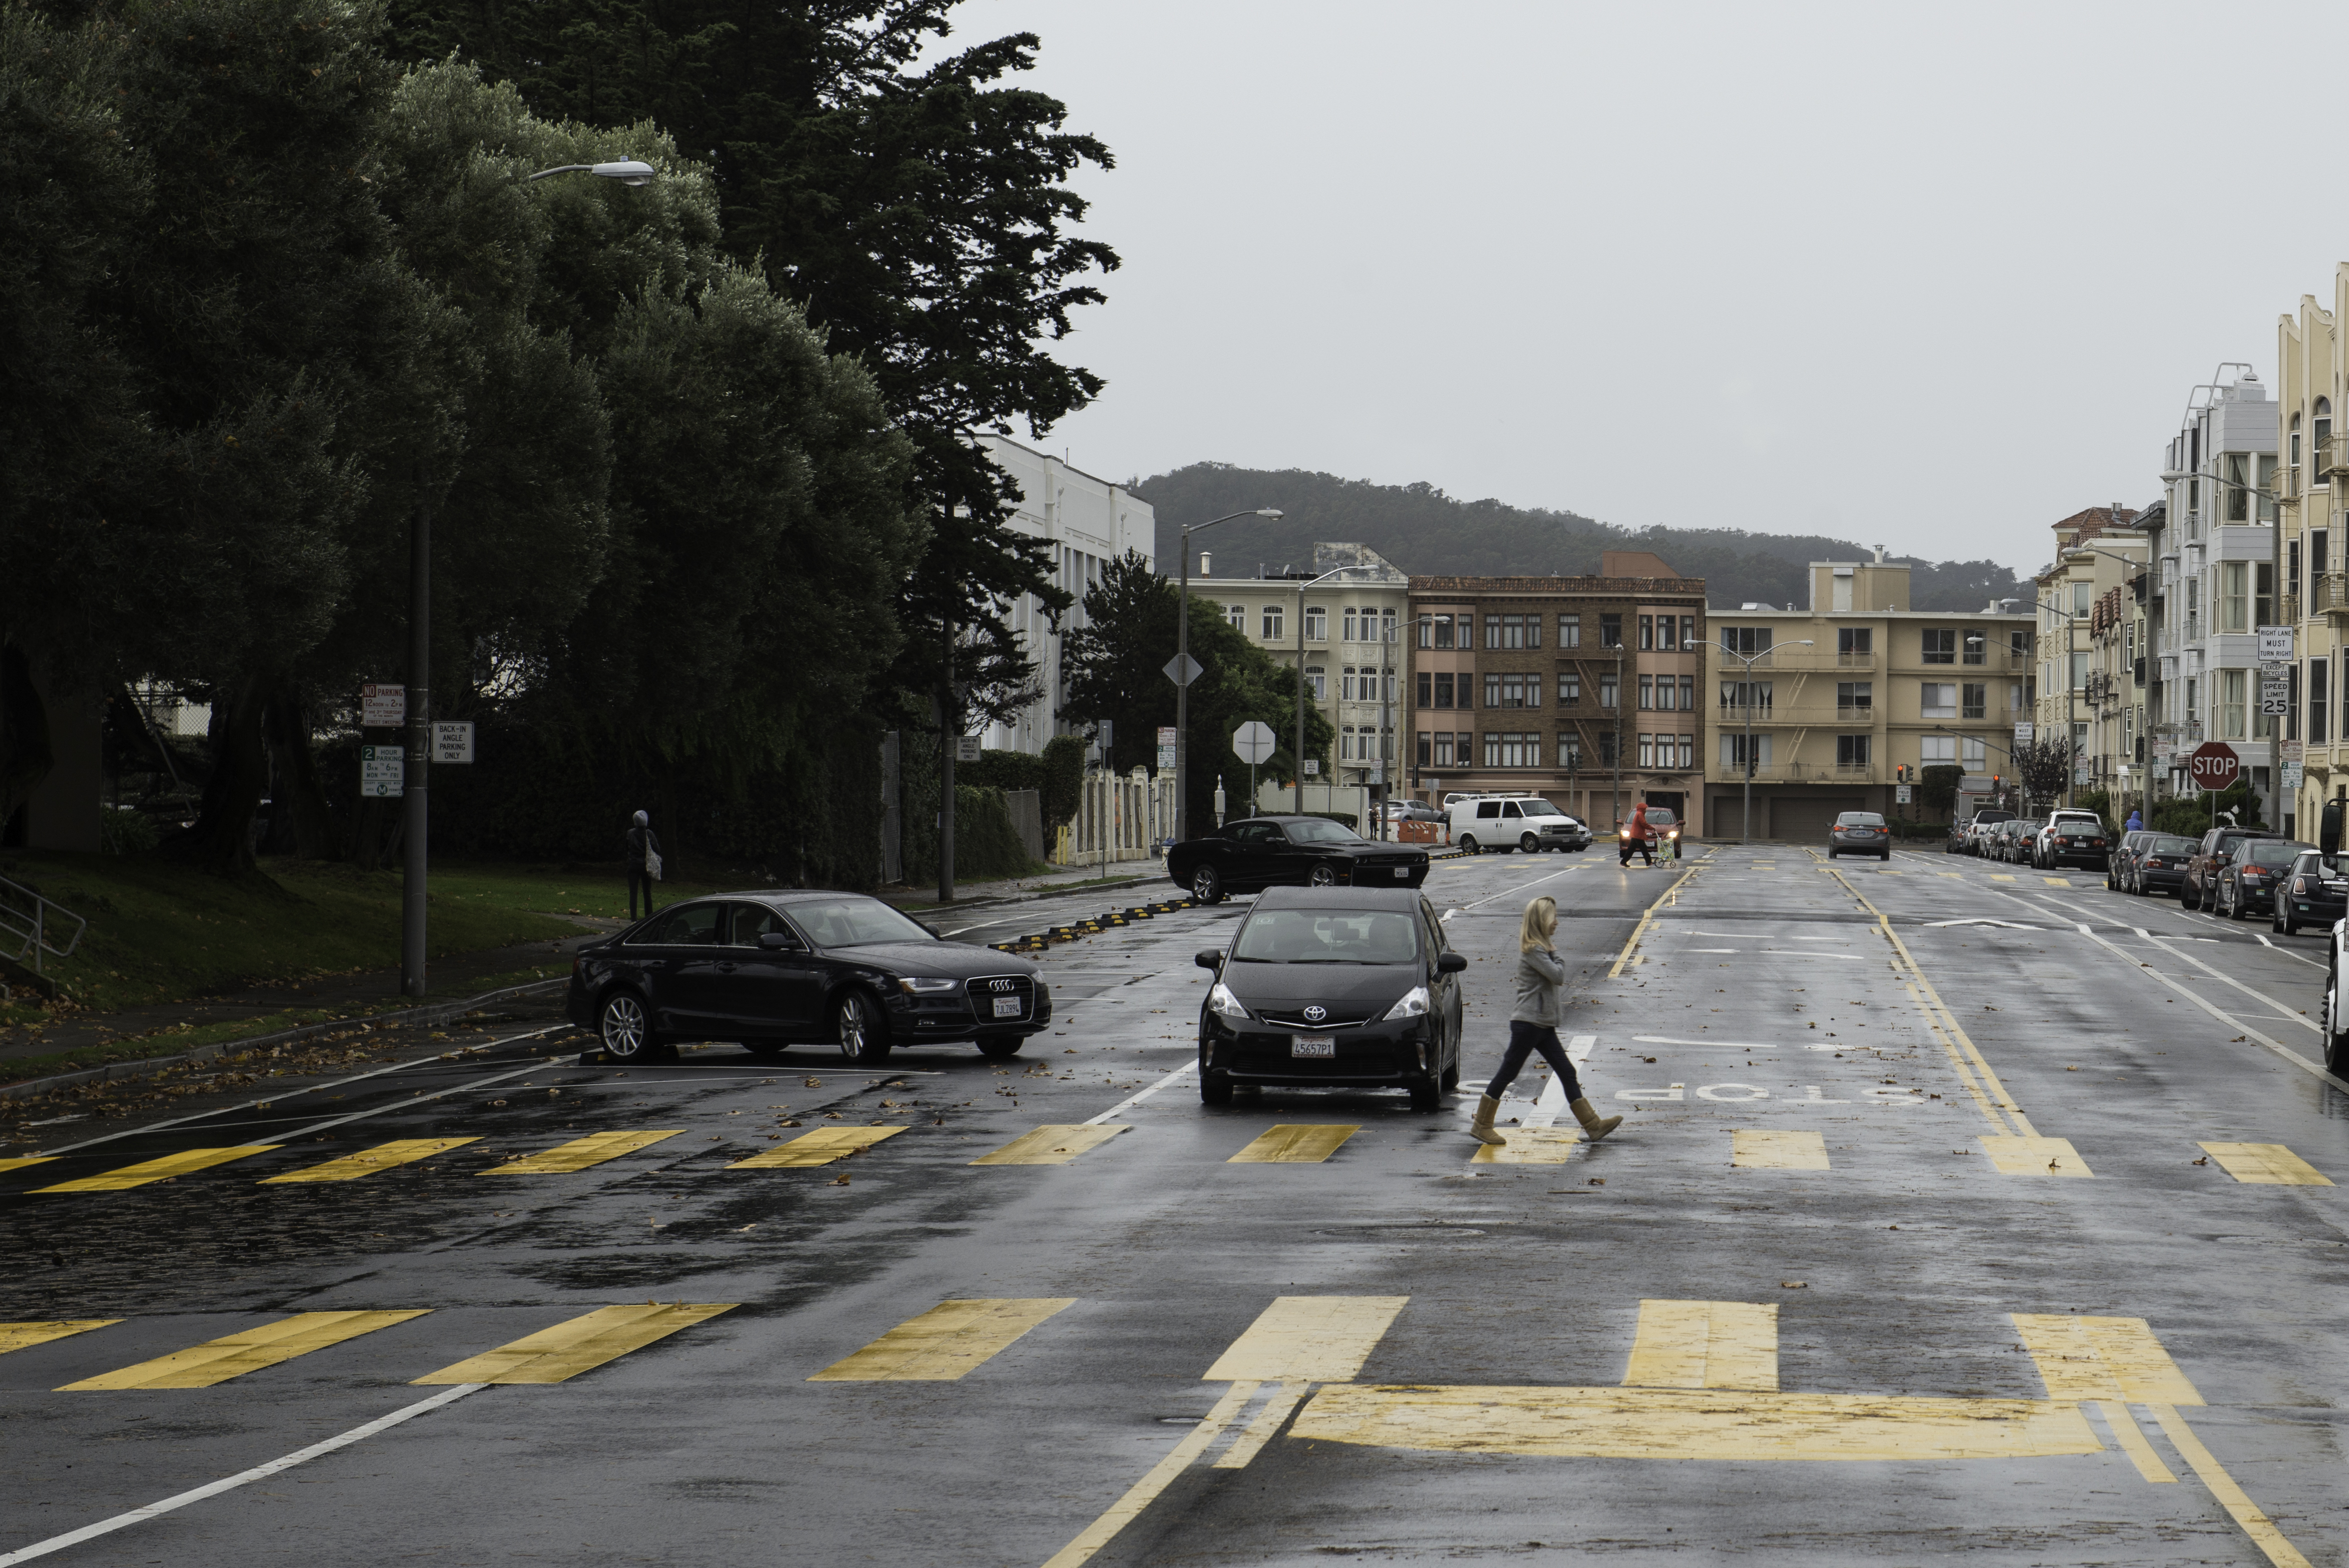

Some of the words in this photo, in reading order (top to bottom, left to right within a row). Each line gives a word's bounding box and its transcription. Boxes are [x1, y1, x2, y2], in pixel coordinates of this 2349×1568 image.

[365, 686, 375, 696] NO
[378, 689, 403, 697] PARKING
[2264, 700, 2286, 713] 25
[365, 748, 373, 759] 2
[2193, 757, 2236, 775] STOP
[379, 786, 386, 794] M
[995, 1004, 1019, 1014] 7JLZ894
[1295, 1044, 1332, 1054] 45657P1
